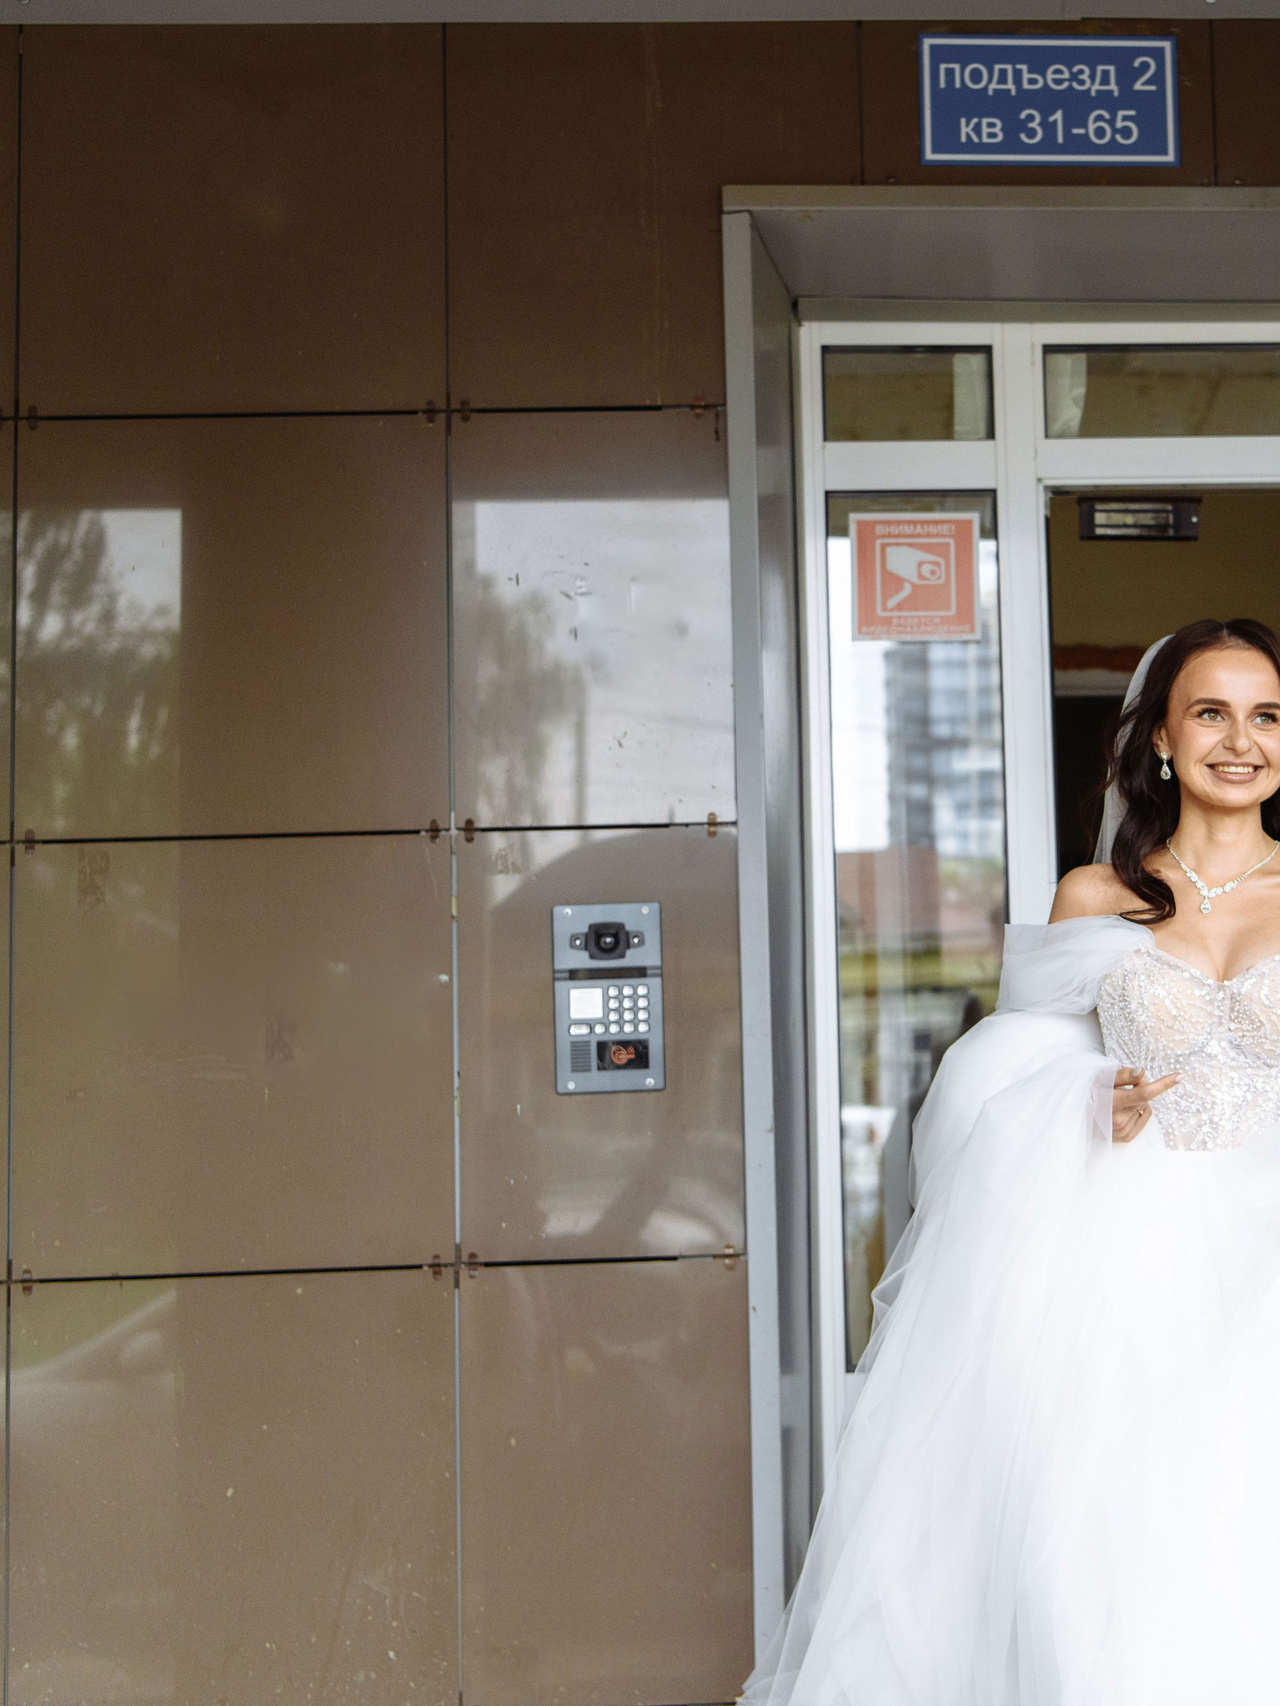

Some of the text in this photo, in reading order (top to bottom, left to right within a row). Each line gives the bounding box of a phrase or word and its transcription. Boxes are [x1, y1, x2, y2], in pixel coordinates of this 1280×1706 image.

[939, 56, 1157, 97] подъезд 2
[959, 109, 1139, 145] кв 31-65
[875, 524, 956, 535] ВНИМАНИЕ!
